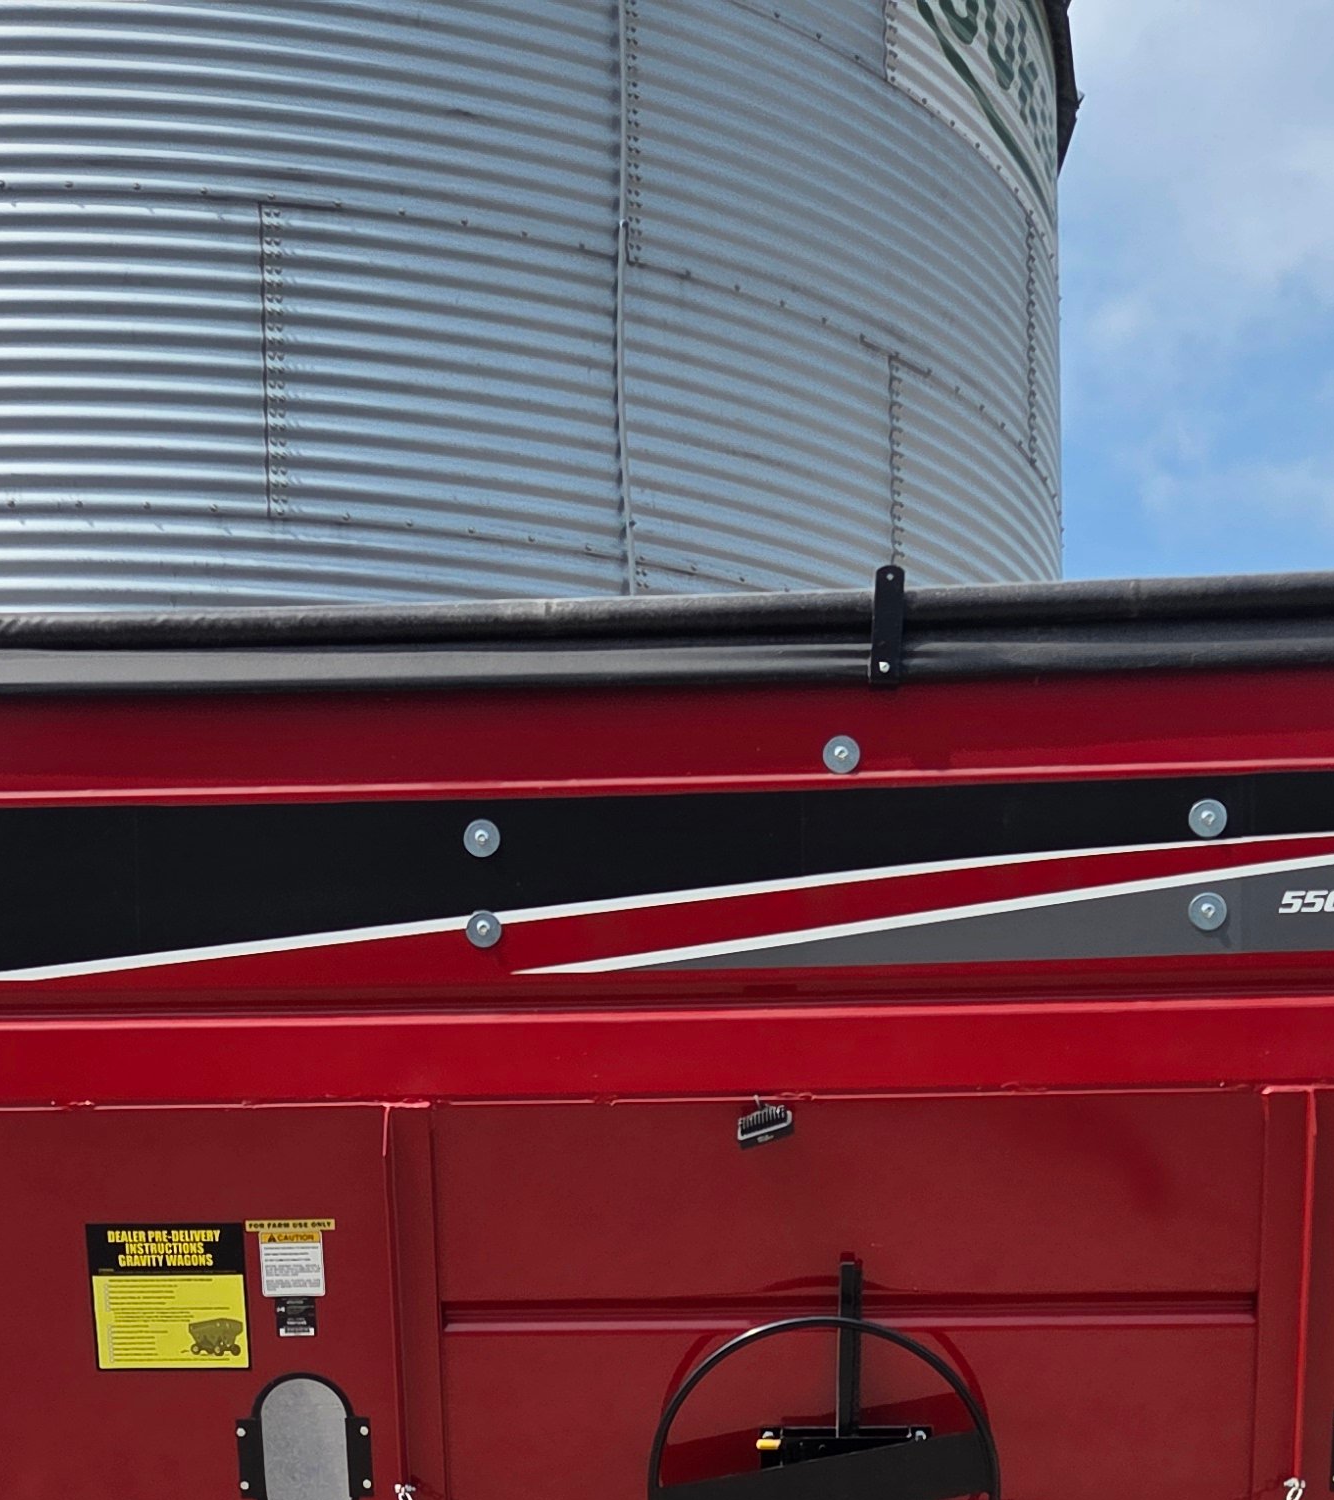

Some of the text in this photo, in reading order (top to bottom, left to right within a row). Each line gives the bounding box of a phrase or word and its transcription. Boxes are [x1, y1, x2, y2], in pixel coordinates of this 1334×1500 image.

[107, 1229, 220, 1243] DEALER PRE-DELIVERY
[125, 1242, 204, 1254] INSTRUCTIONS
[118, 1254, 214, 1267] GRAVITY WAGONS
